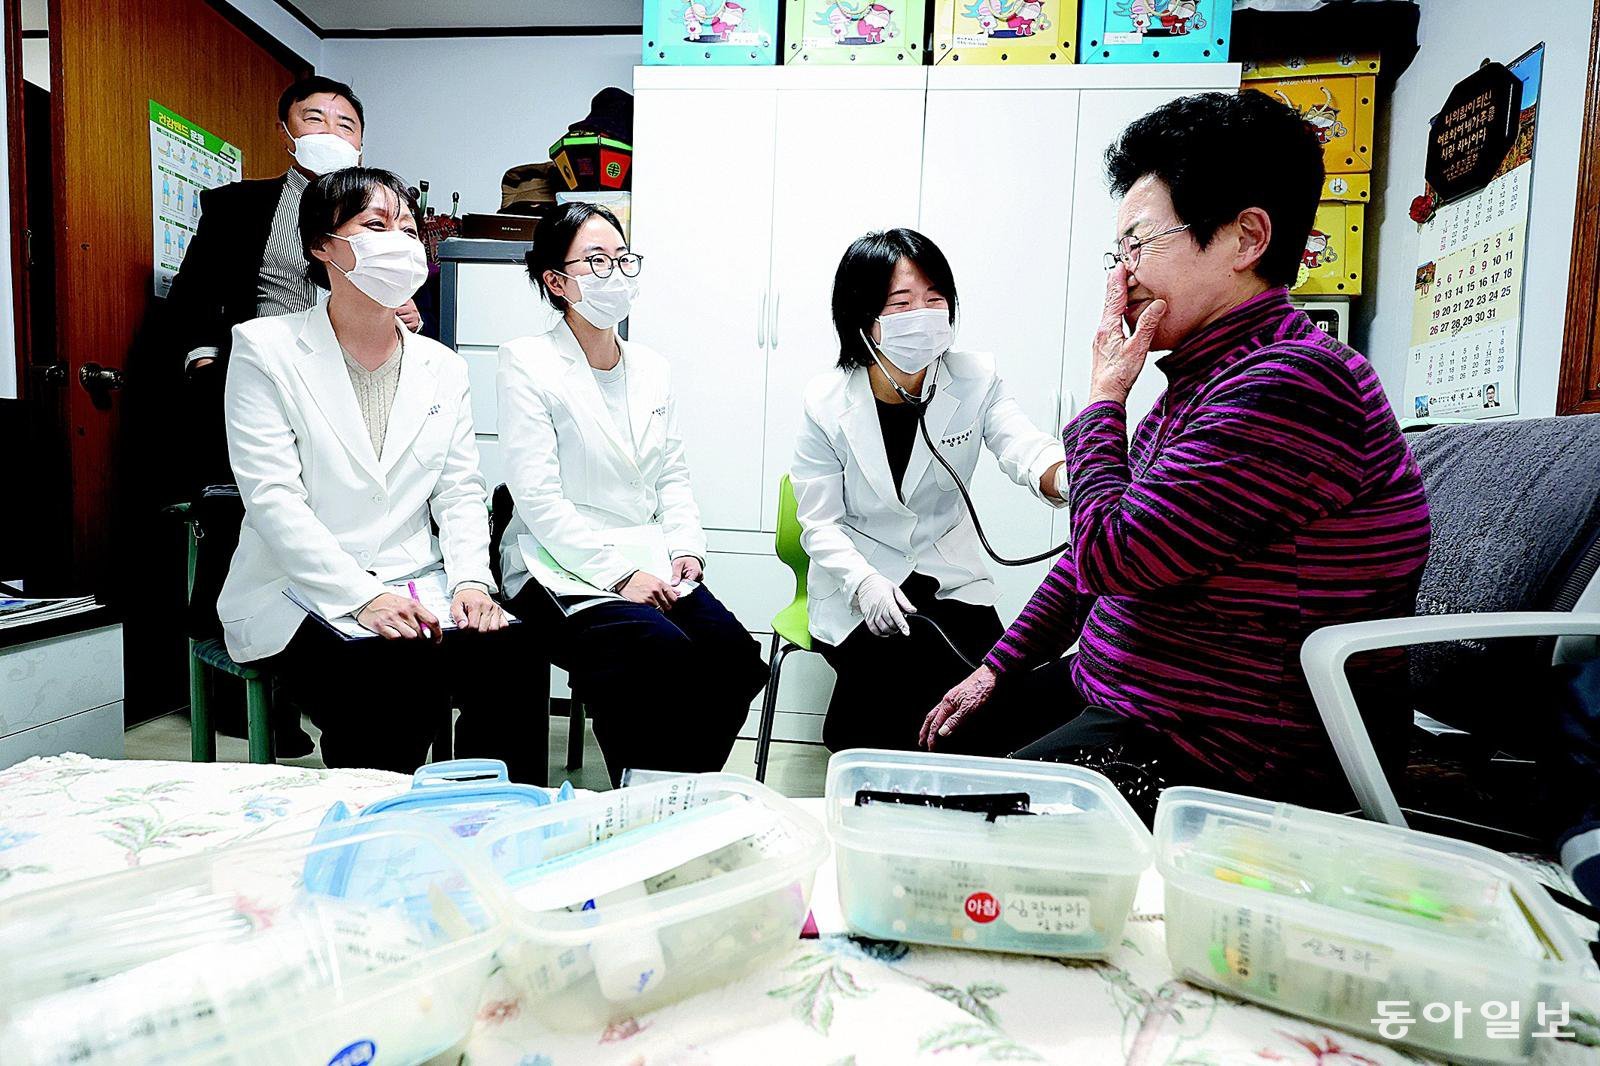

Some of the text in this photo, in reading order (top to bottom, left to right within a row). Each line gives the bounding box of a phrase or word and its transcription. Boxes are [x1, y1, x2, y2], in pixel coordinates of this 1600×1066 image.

[1472, 233, 1513, 257] 1 2 3 4
[1437, 250, 1513, 287] 5 6 7 8 9 10 11
[1420, 284, 1429, 296] 10
[1435, 268, 1512, 303] 12 13 14 15 16 17 18
[1433, 286, 1511, 319] 19 20 21 22 23 24 25
[1430, 308, 1496, 335] 26 27 28 29 30 31
[967, 899, 996, 916] 아침
